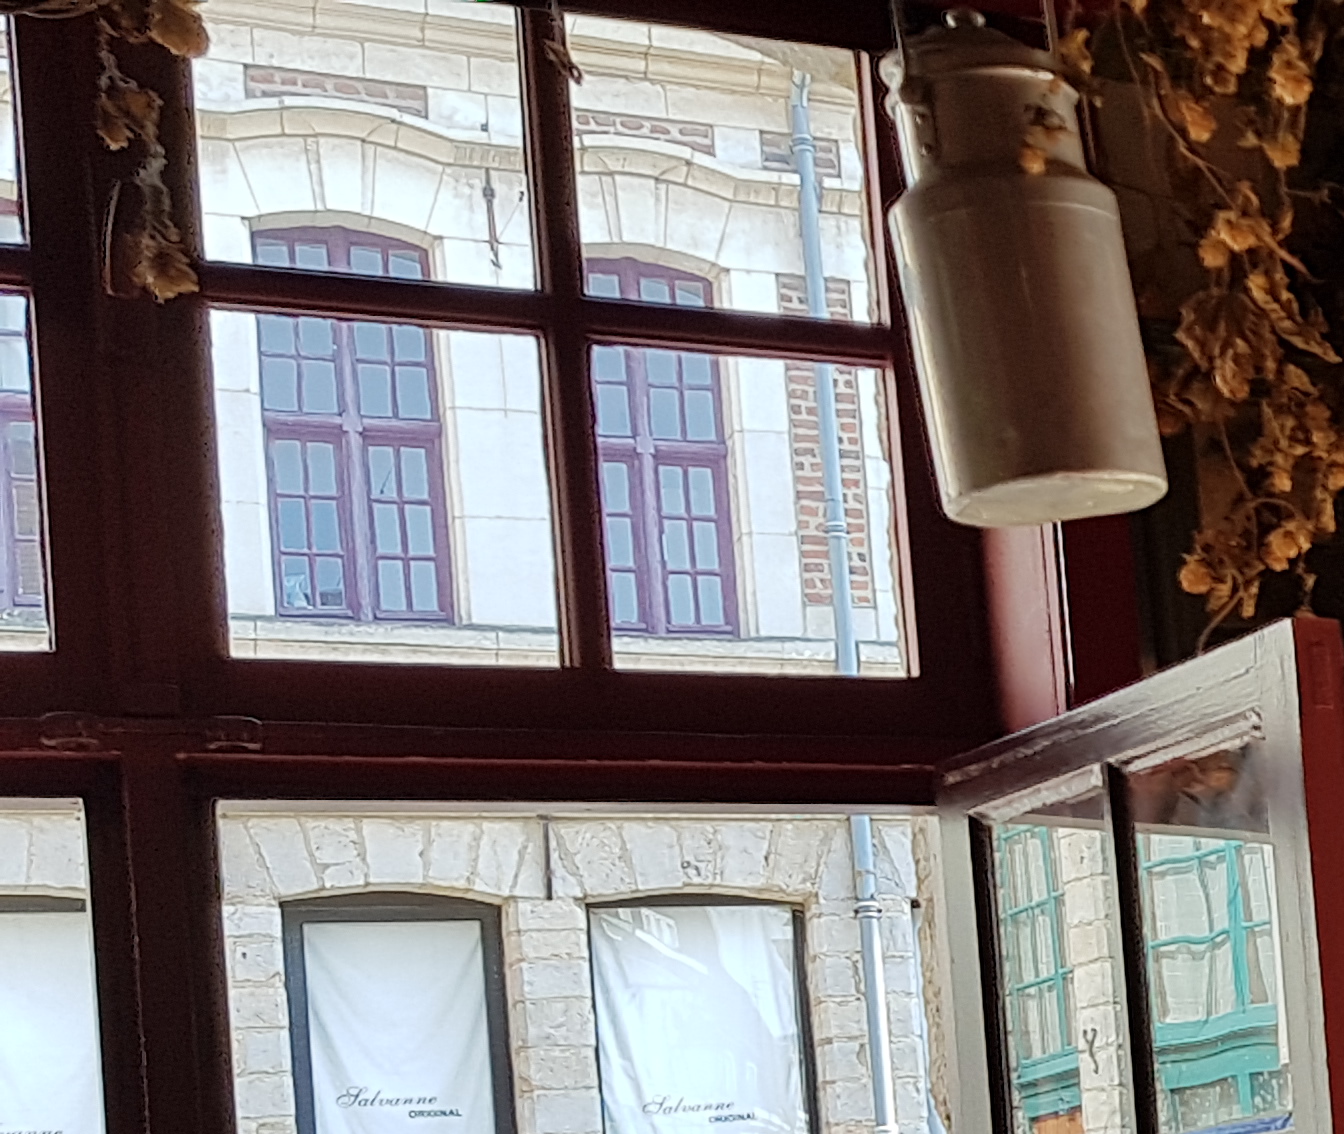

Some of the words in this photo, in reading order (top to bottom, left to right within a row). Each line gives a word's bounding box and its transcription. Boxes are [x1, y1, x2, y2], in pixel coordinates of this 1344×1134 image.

[336, 1086, 438, 1109] Salvanne
[642, 1094, 735, 1115] Salvanne
[408, 1109, 463, 1119] ORIGINAL
